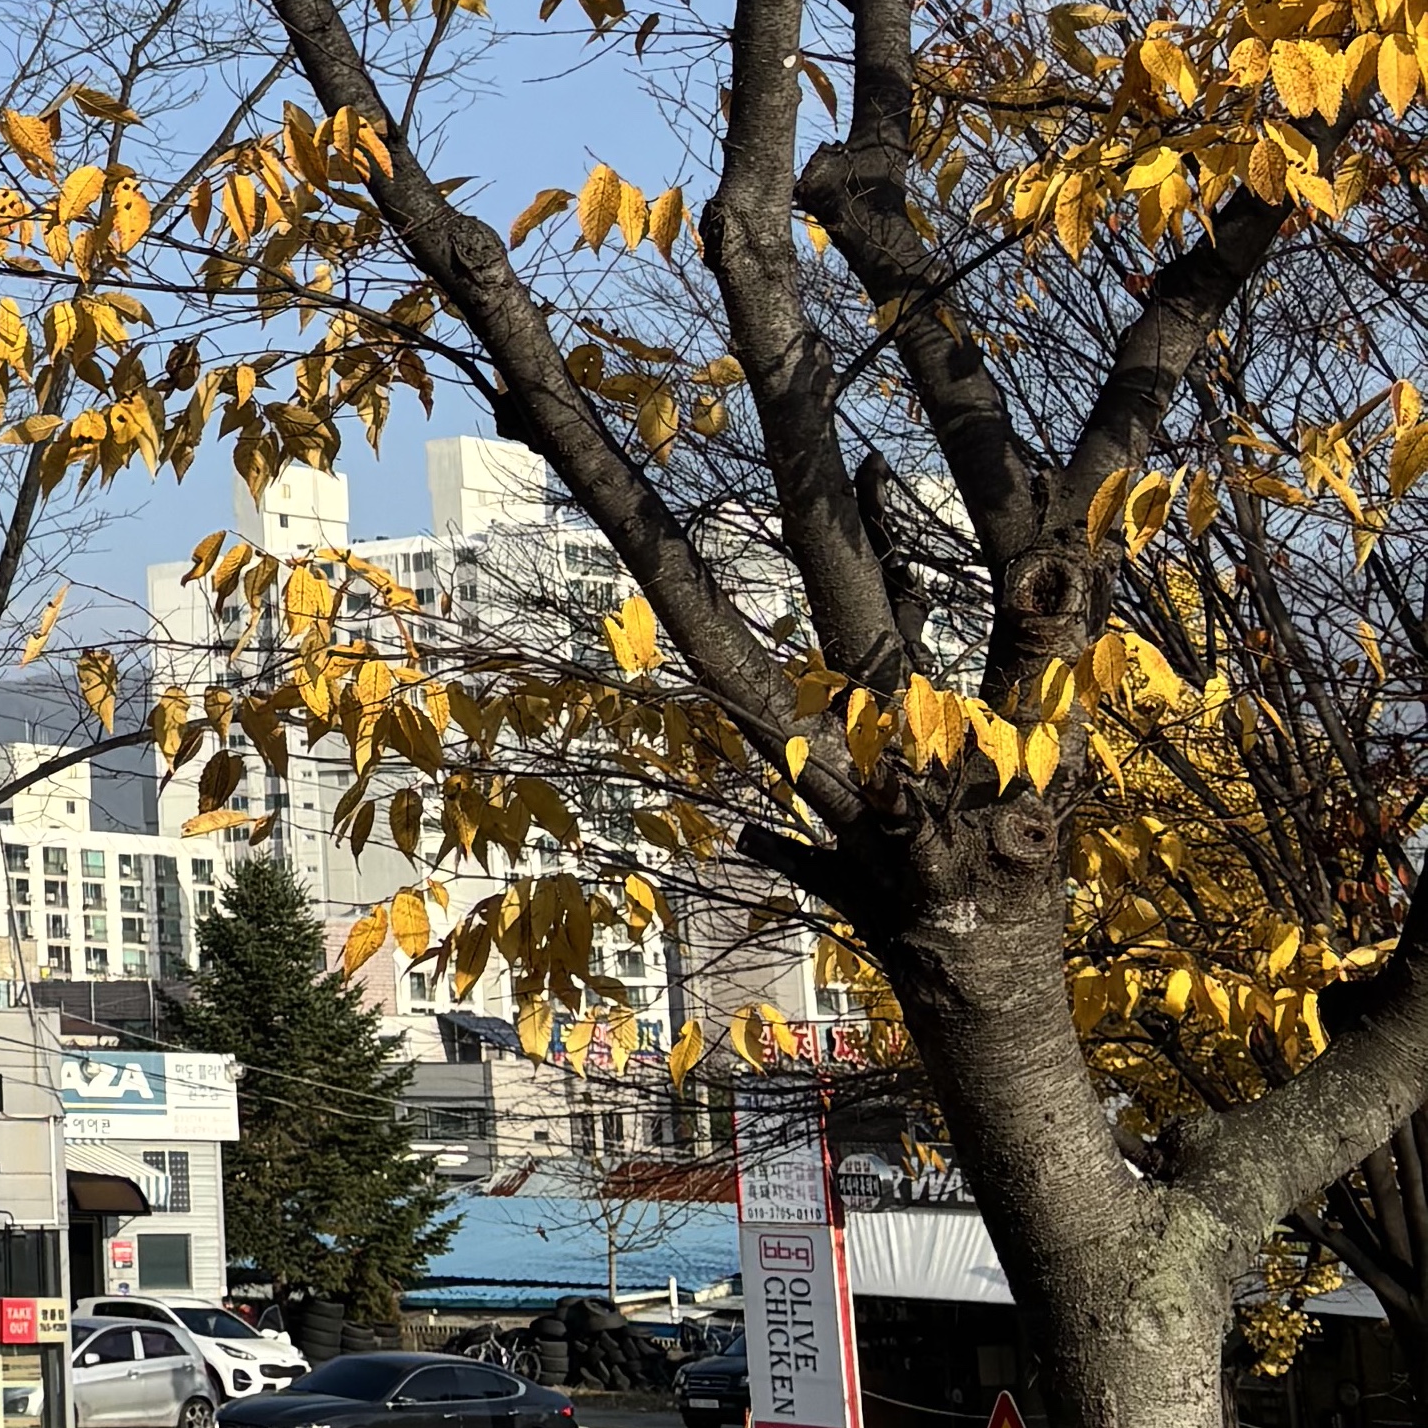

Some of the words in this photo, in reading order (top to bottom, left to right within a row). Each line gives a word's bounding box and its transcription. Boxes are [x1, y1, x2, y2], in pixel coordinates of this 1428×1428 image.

[6, 1307, 32, 1320] TAKE
[10, 1323, 29, 1334] OUT
[789, 1277, 820, 1373] OLIVE
[764, 1277, 796, 1417] CHICKEN
